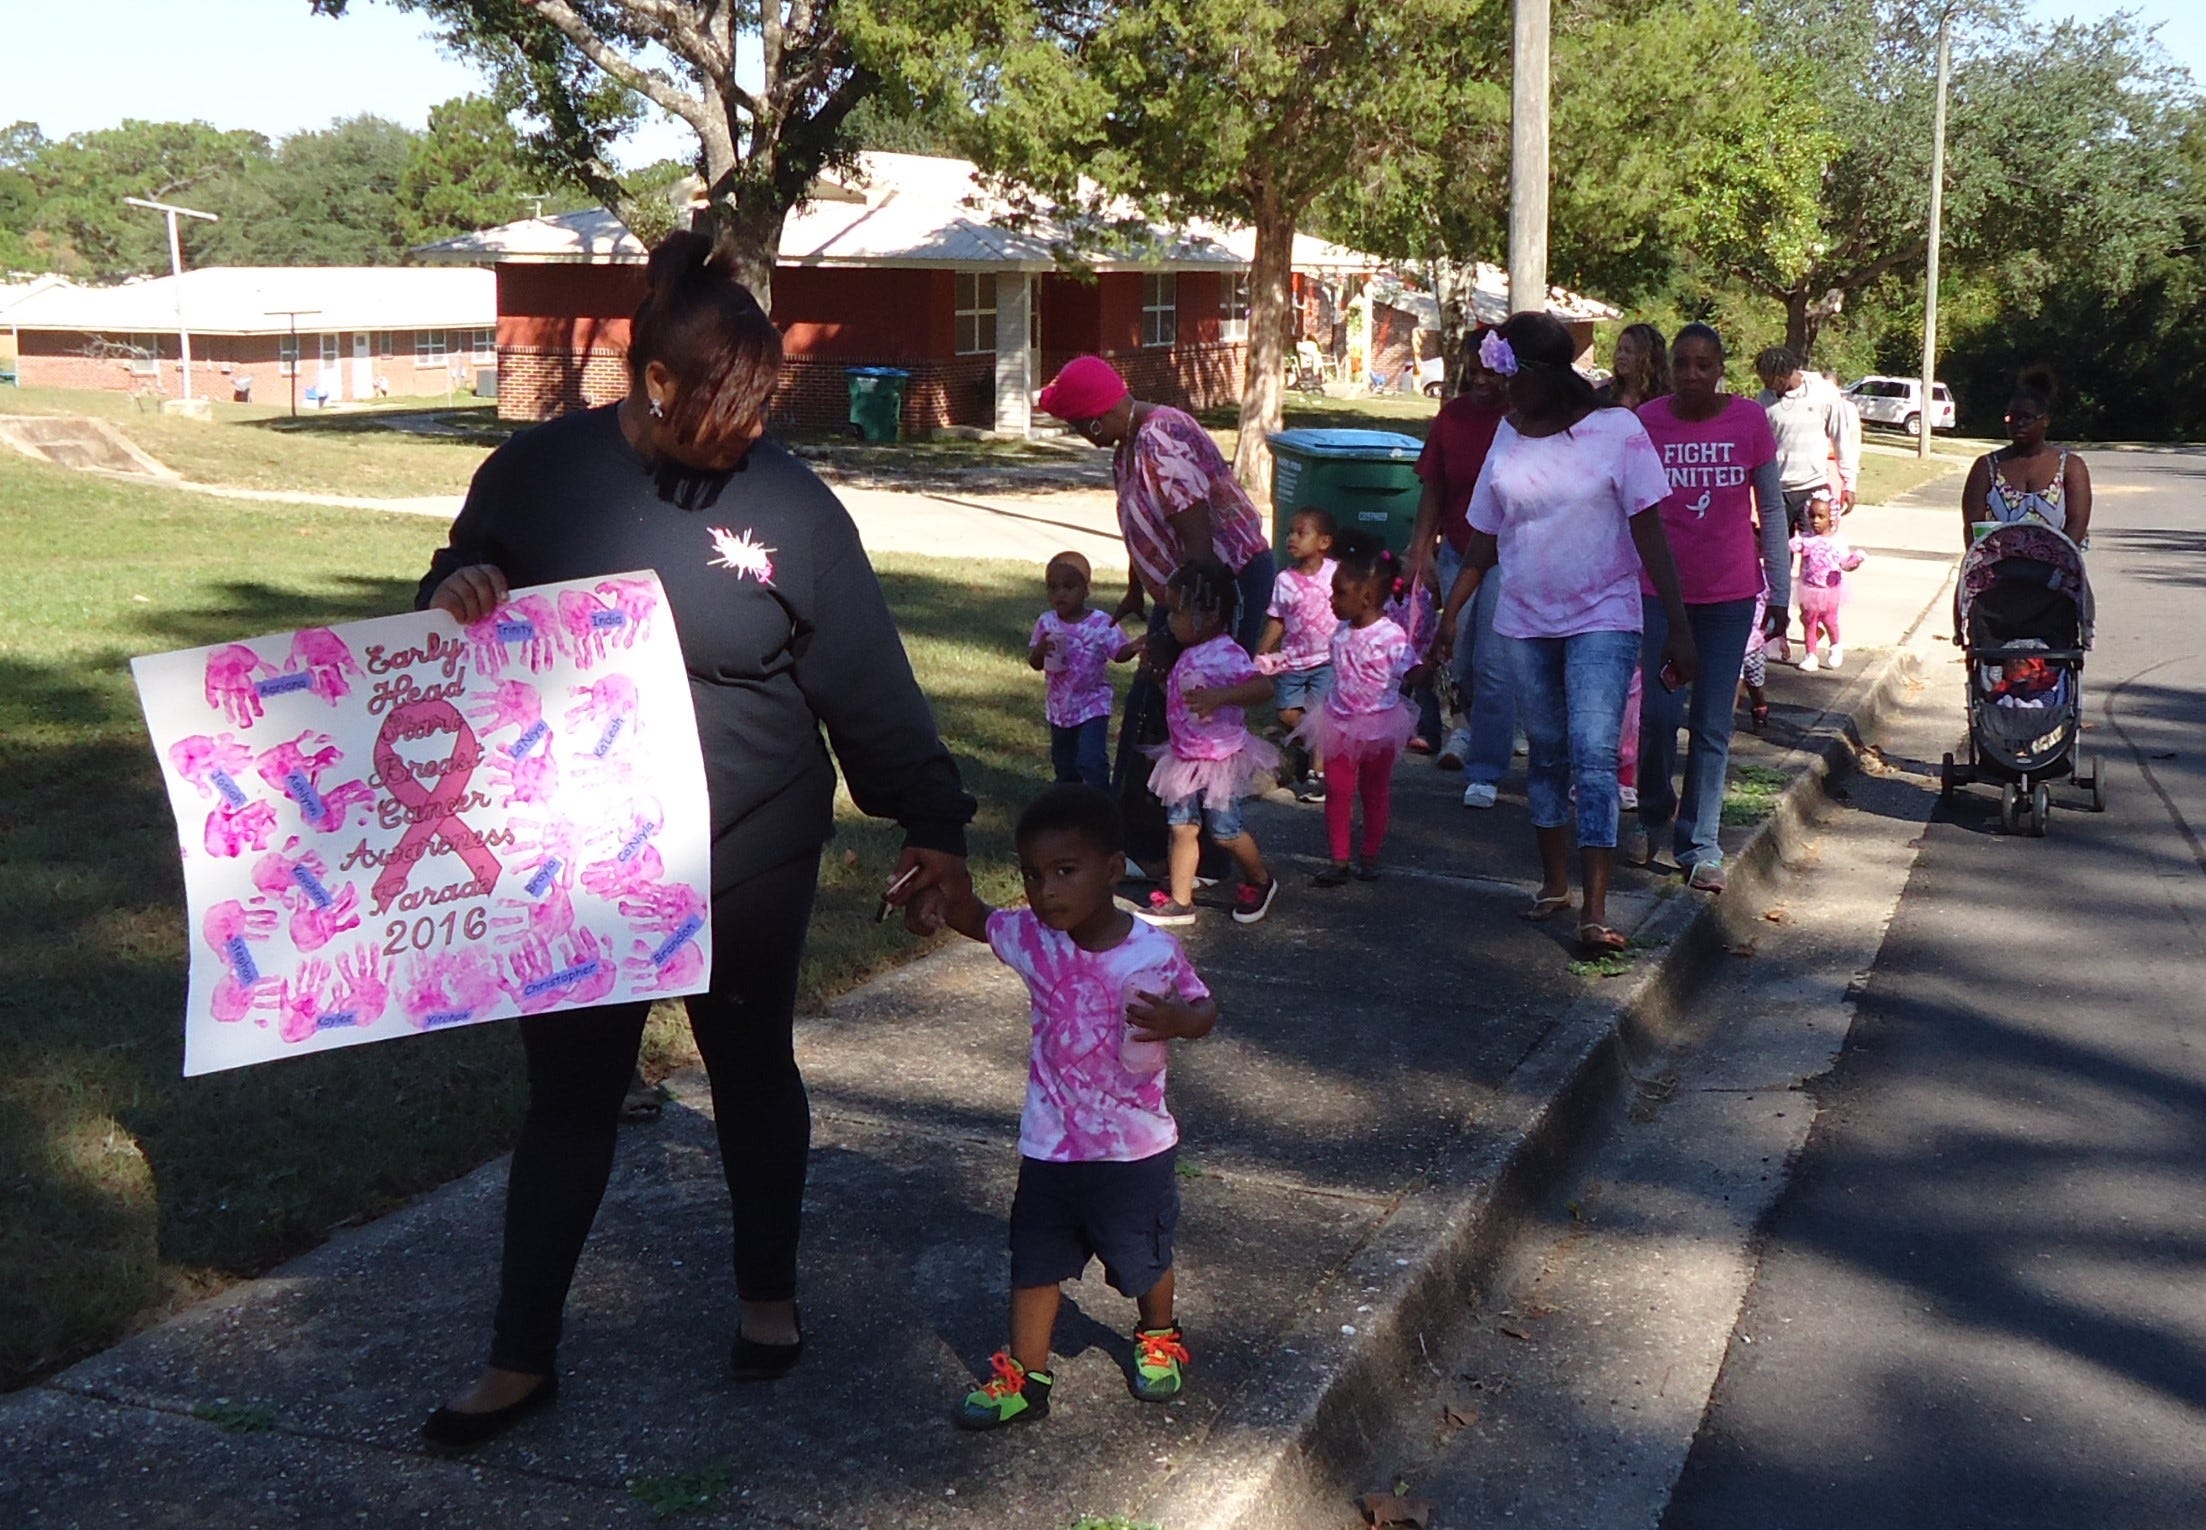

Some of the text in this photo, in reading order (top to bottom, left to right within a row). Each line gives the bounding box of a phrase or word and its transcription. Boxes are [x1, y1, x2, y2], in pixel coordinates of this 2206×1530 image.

[1664, 443, 1735, 464] FIGHT
[591, 615, 623, 627] India
[365, 632, 466, 678] Early
[367, 666, 466, 716] Head
[381, 713, 464, 745] Start
[368, 742, 485, 789] Breast
[210, 771, 242, 806] Josiah
[377, 791, 492, 830] Cancer
[339, 827, 516, 872] Awareness
[368, 865, 492, 916] Parade
[524, 859, 556, 894] Brayla
[382, 906, 488, 956] 2016
[652, 922, 695, 965] Brandon
[523, 962, 597, 996] Christopher
